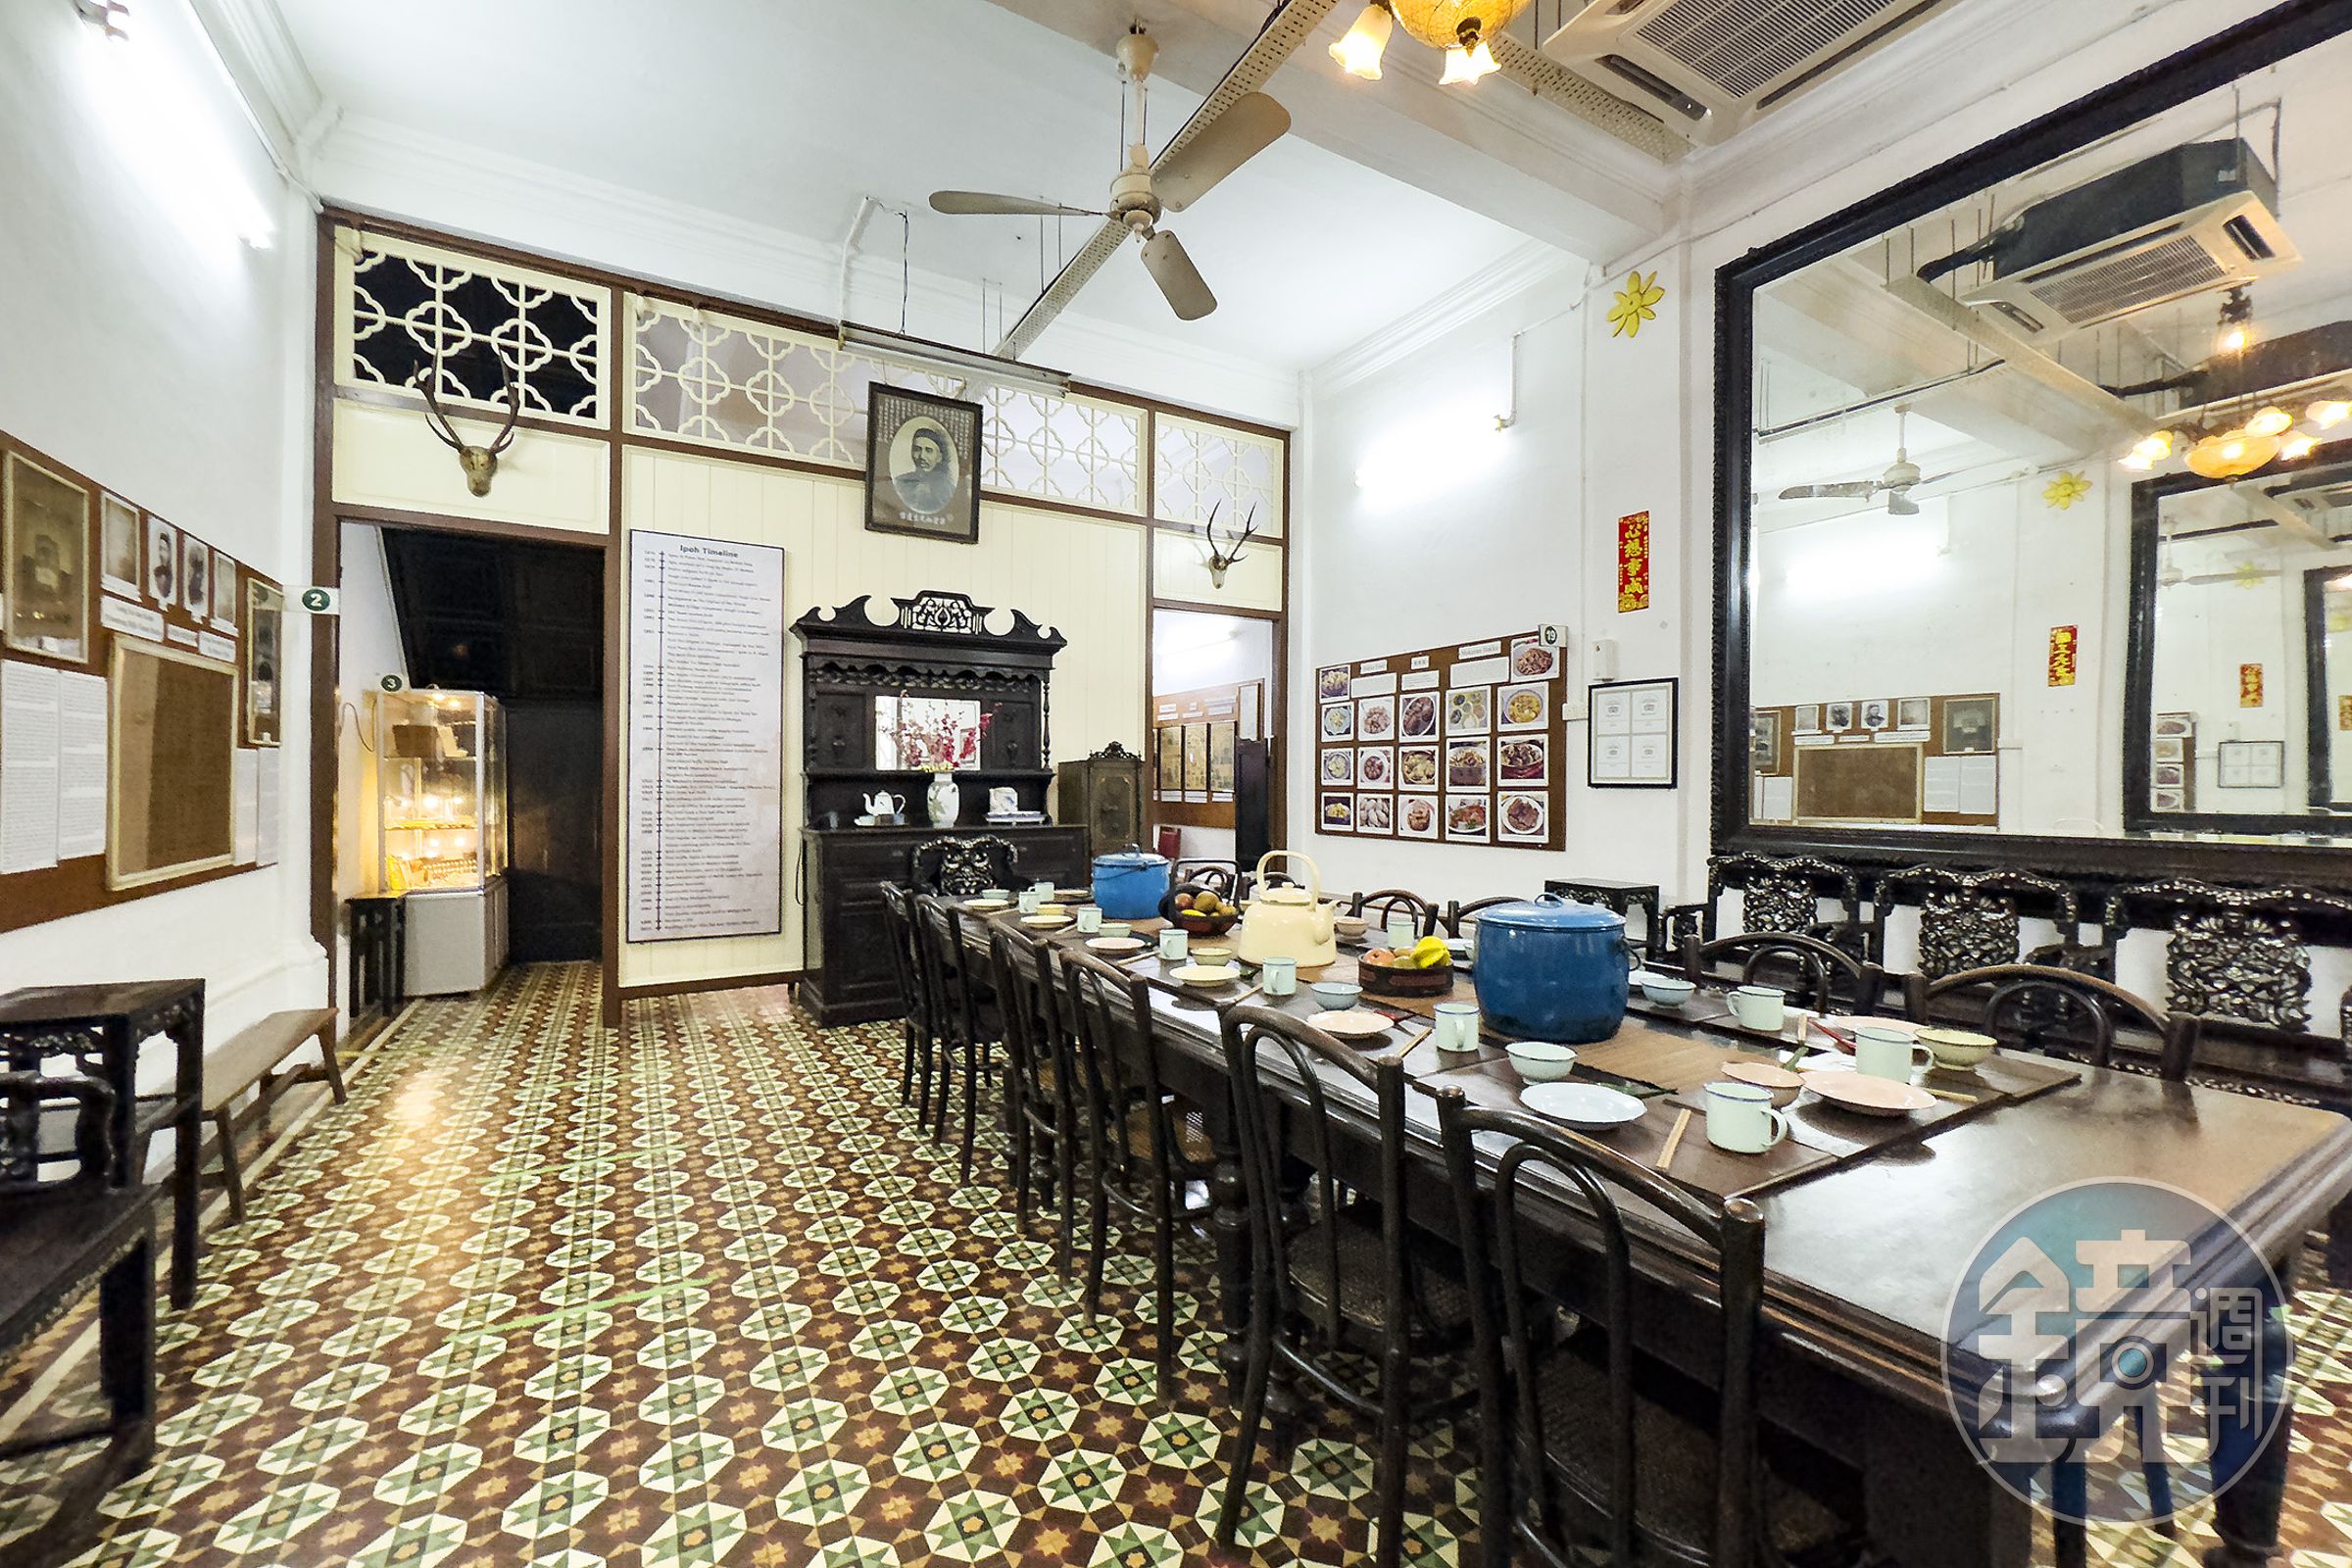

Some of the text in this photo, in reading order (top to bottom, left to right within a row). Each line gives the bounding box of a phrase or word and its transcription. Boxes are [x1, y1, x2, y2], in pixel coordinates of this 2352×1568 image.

[679, 544, 739, 559] Ipoh Timeline
[1624, 523, 1643, 594] 心想事成
[310, 593, 322, 607] 2
[1545, 629, 1555, 642] 19
[387, 677, 397, 689] 3
